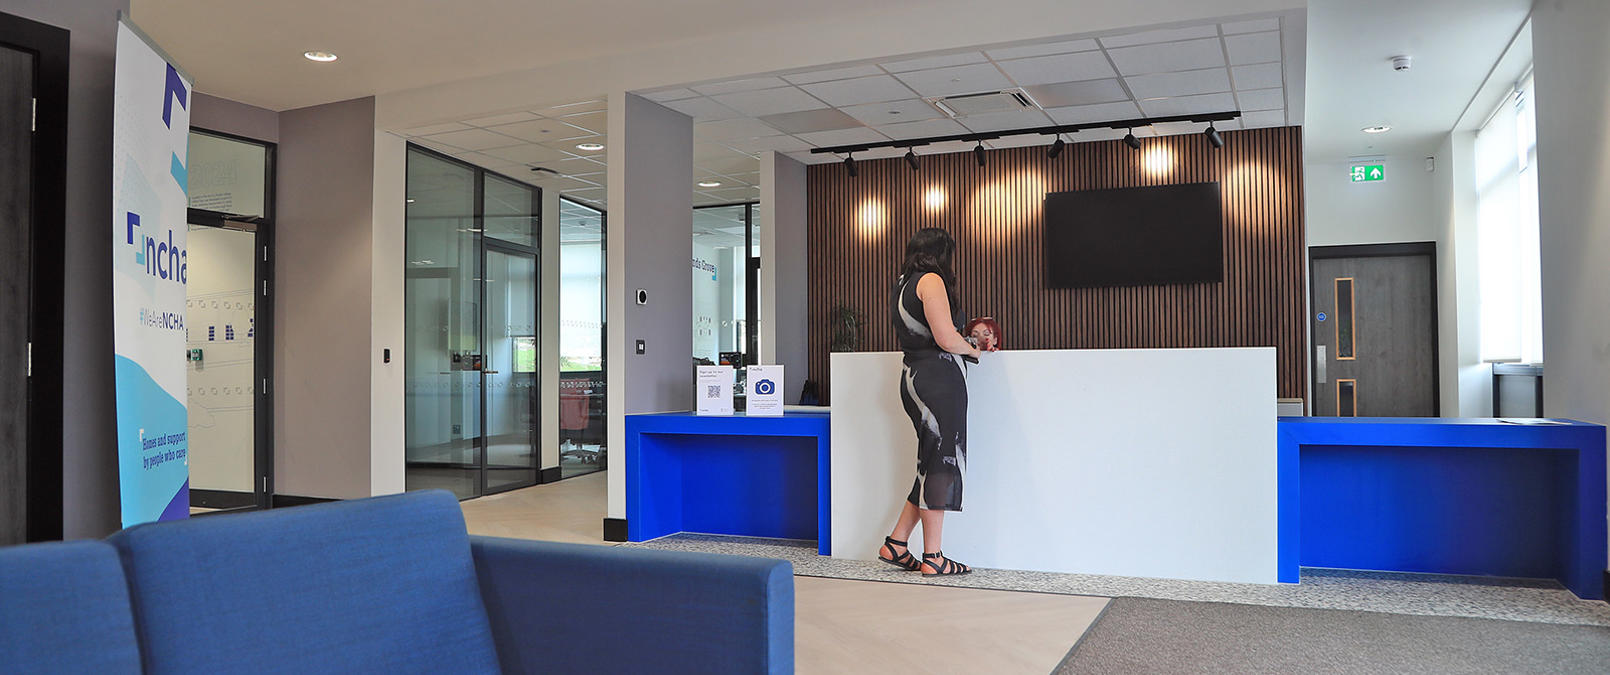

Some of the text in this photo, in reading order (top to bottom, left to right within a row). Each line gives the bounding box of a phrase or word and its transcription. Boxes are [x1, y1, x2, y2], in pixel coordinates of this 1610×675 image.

[146, 230, 186, 285] ncha
[140, 308, 184, 331] #WeAreNCHA
[143, 432, 185, 450] Homes and support
[143, 449, 185, 470] by people who care
